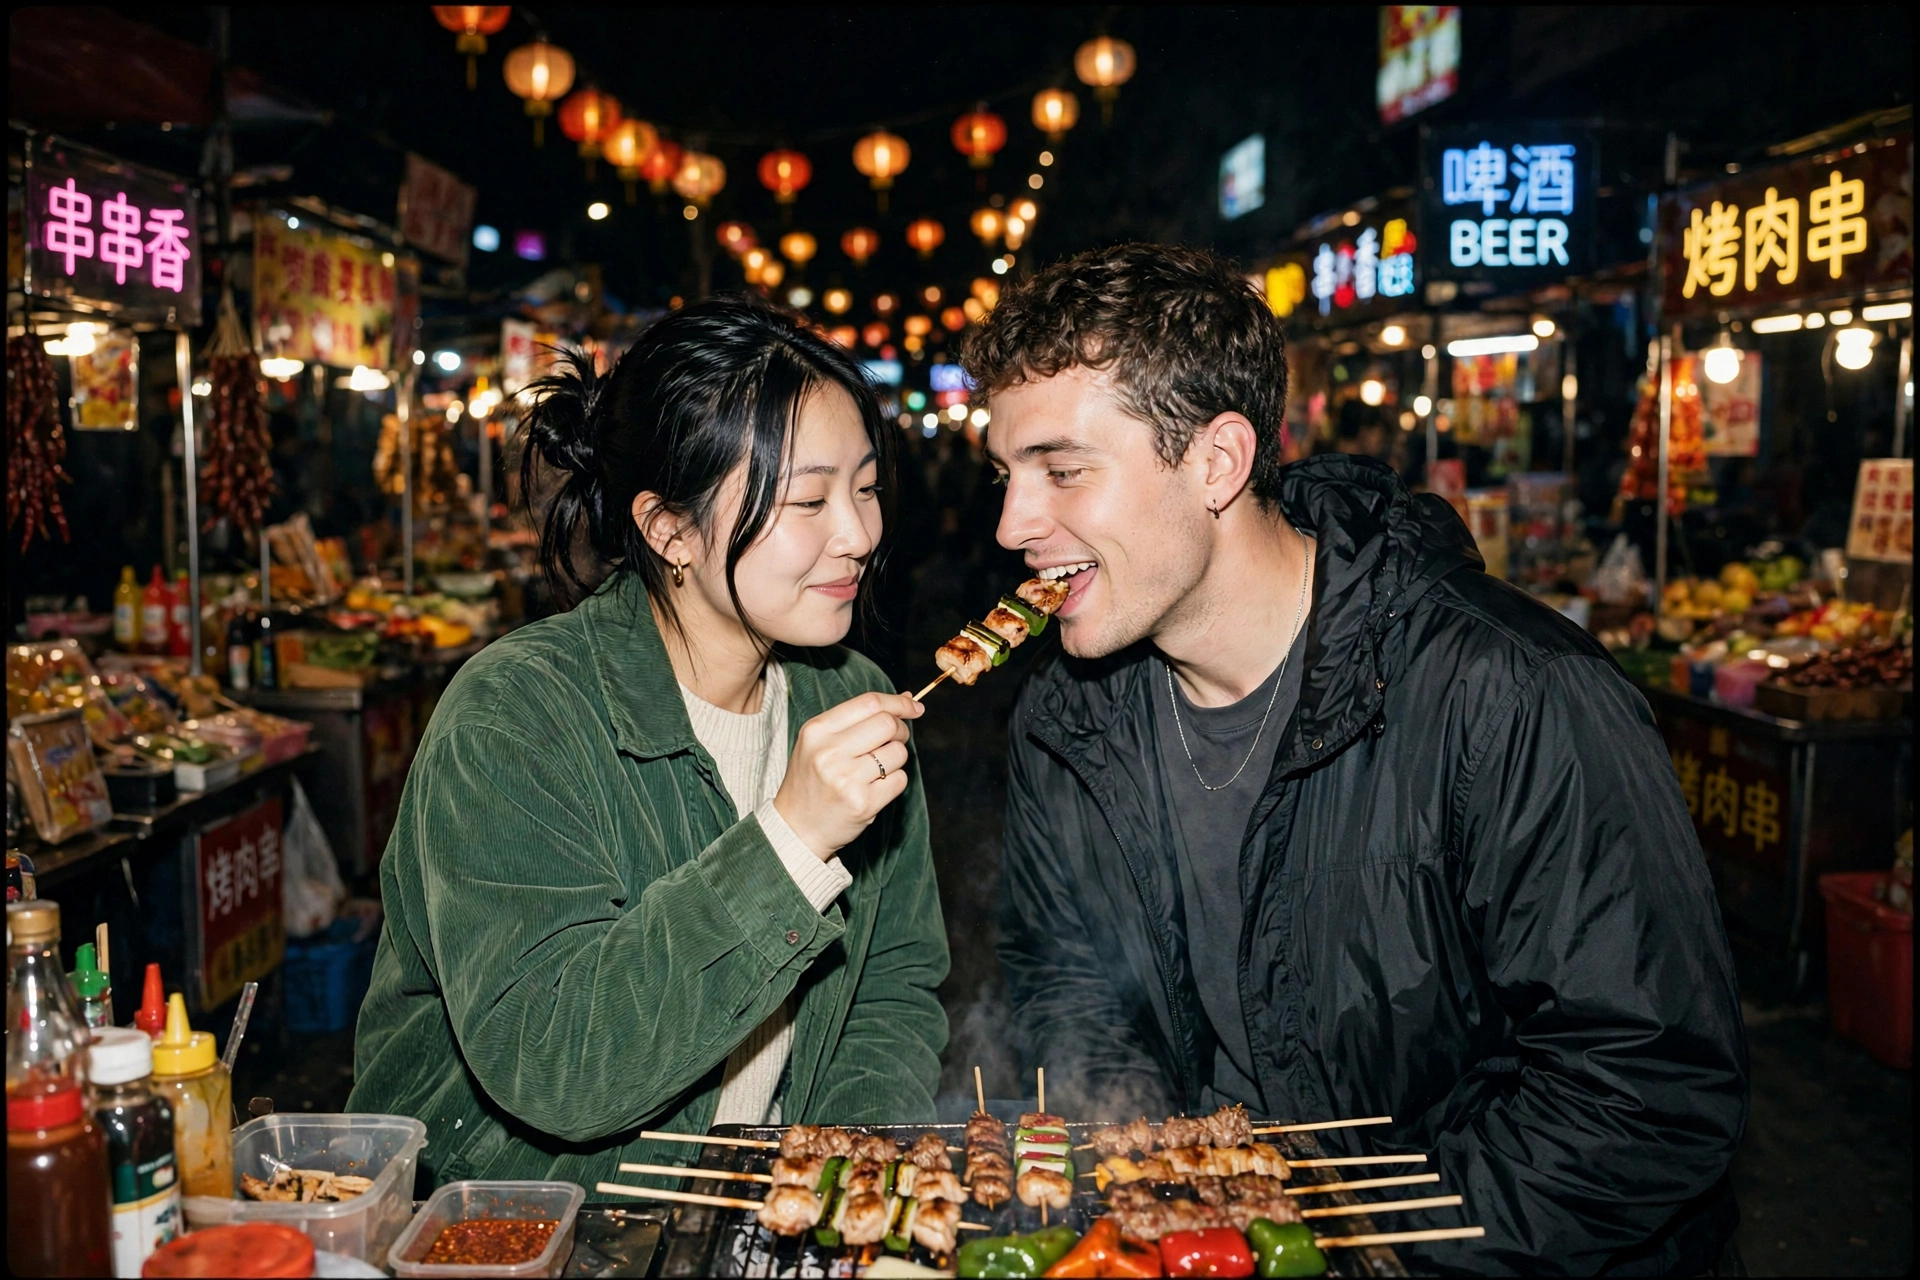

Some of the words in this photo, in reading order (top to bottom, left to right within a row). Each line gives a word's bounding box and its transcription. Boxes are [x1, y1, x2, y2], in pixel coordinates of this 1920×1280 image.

[1443, 141, 1577, 217] 啤酒
[46, 177, 191, 293] 串串香
[1450, 218, 1569, 267] BEER
[1682, 170, 1868, 299] 烤肉串
